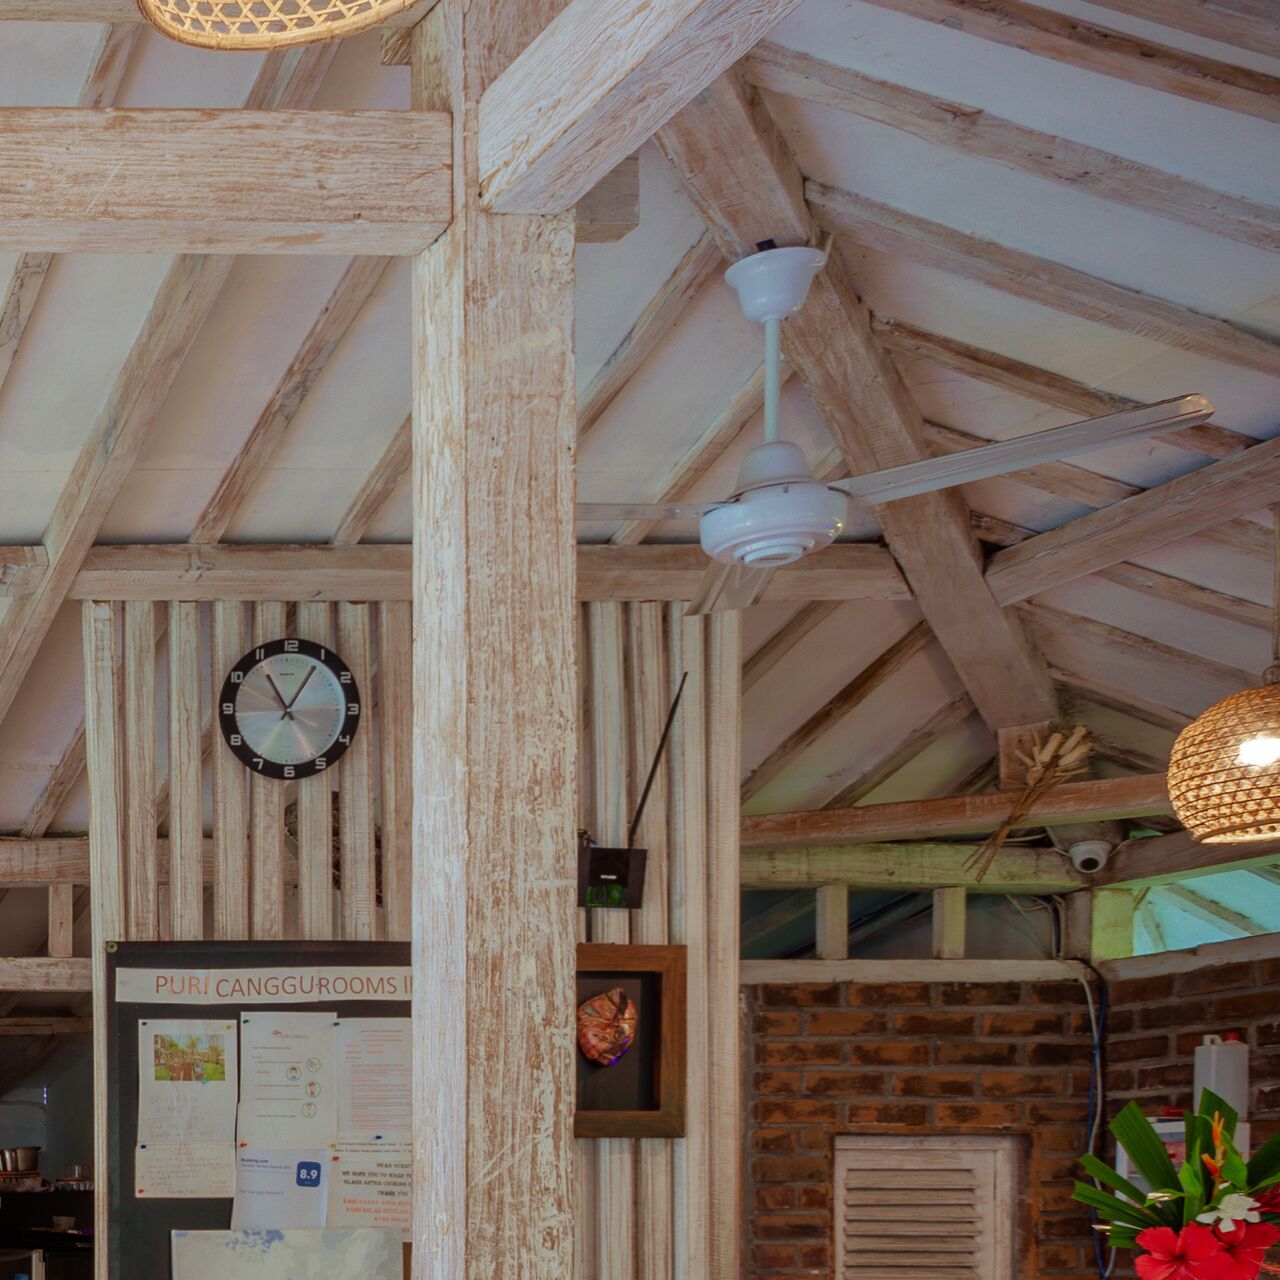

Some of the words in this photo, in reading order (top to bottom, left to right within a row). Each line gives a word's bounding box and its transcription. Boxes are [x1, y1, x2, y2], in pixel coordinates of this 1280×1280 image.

[284, 640, 299, 652] 12
[256, 648, 264, 660] 11
[321, 649, 325, 660] 1
[231, 671, 244, 683] 10
[340, 671, 351, 683] 2
[222, 703, 233, 715] 9
[347, 703, 359, 715] 3
[230, 734, 242, 746] 8
[339, 734, 350, 746] 4
[252, 758, 264, 770] 7
[315, 757, 327, 769] 5
[284, 766, 295, 778] 6
[155, 975, 209, 996] PURI
[215, 975, 315, 998] CANGGU
[318, 975, 398, 995] ROOMS
[299, 1169, 318, 1180] 8.9
